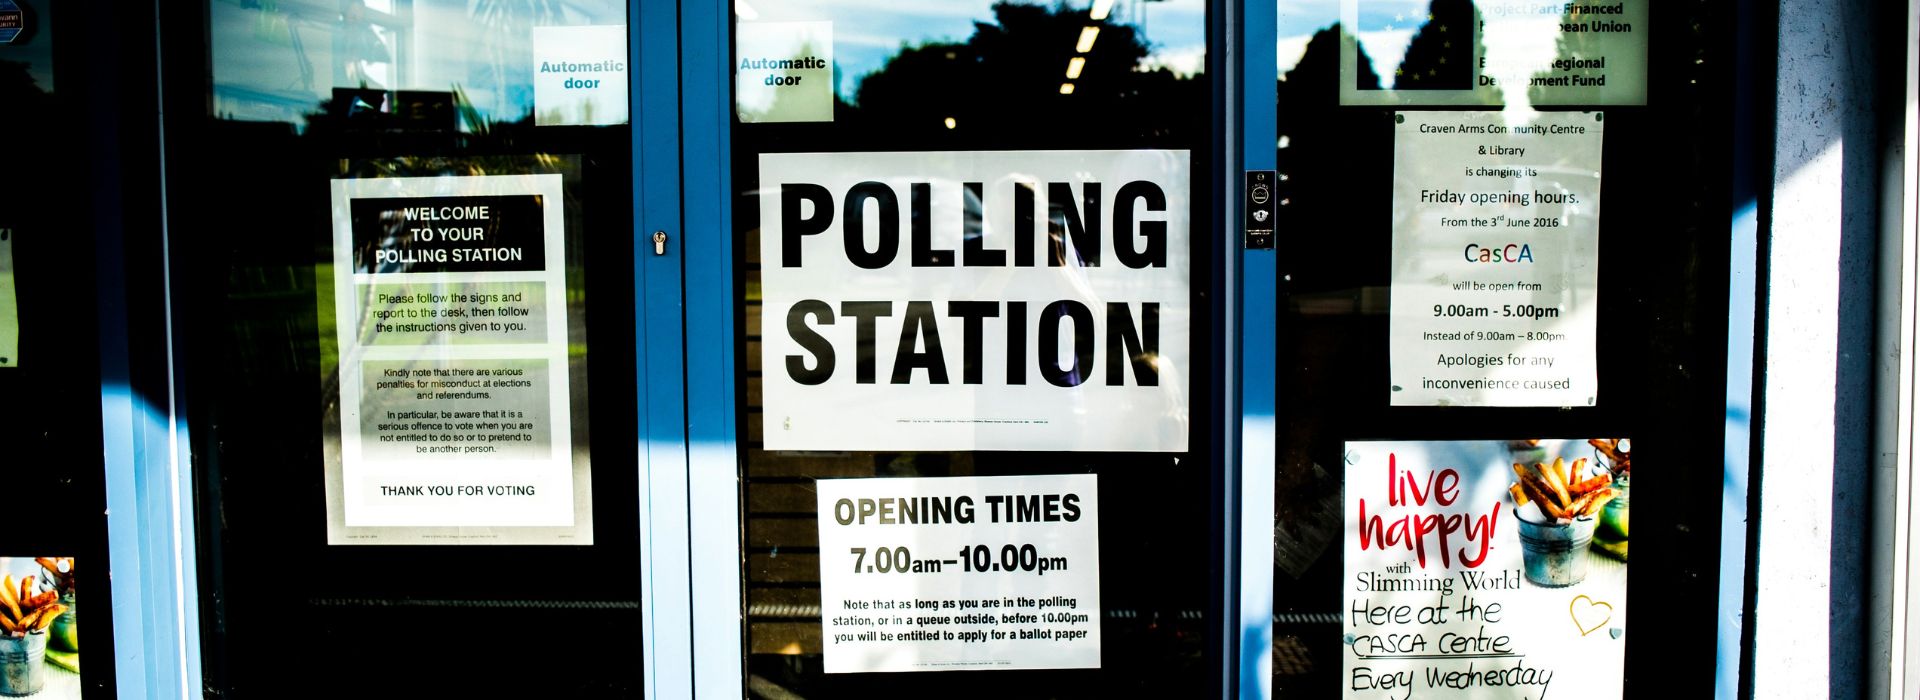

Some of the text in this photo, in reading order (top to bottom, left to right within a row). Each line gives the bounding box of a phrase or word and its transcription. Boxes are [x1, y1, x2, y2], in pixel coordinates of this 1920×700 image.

[1481, 3, 1623, 16] Project Part-Financed
[1591, 20, 1632, 33] Union
[541, 60, 624, 73] Automatic
[740, 56, 826, 70] Automatic
[564, 77, 600, 89] door
[764, 74, 802, 86] door
[1571, 74, 1606, 87] Fund
[1419, 124, 1455, 134] Craven
[1458, 124, 1485, 134] Arms
[1549, 124, 1585, 134] Centre
[1478, 145, 1525, 157] & Library
[1465, 167, 1537, 179] is changing its
[1420, 189, 1580, 206] Friday opening hours.
[404, 206, 490, 222] WELCOME
[780, 180, 1168, 270] POLLING
[1441, 217, 1468, 227] From
[1470, 217, 1488, 227] the
[1506, 217, 1531, 227] June
[1533, 217, 1559, 227] 2016
[410, 227, 484, 242] TO YOUR
[375, 247, 523, 264] POLLING STATION
[1464, 243, 1534, 263] CasCA
[1452, 281, 1542, 293] will be open from
[379, 292, 522, 305] Please follow the signs and
[373, 306, 529, 321] report to the desk, then follow
[1433, 304, 1559, 320] 9.00am 5.00pm
[376, 321, 527, 334] the instructions given to you.
[1423, 331, 1461, 341] Instead
[1463, 330, 1475, 341] of
[1476, 331, 1515, 341] 9.00am
[785, 298, 1161, 388] STATION
[1437, 353, 1555, 368] Apologies for any
[383, 368, 410, 379] Kindly
[412, 368, 431, 377] note
[433, 368, 450, 377] that
[452, 368, 474, 376] there
[491, 368, 523, 376] various
[376, 379, 531, 390] penalties for misconduct at elections
[1422, 376, 1570, 389] inconvenience caused
[416, 391, 492, 400] and referendums.
[387, 410, 396, 419] In
[397, 410, 439, 421] particular,
[441, 410, 452, 419] be
[482, 410, 499, 418] that
[508, 410, 515, 418] is
[378, 422, 409, 431] serious
[411, 422, 442, 431] offence
[444, 422, 452, 430] to
[455, 422, 474, 430] vote
[476, 422, 499, 430] when
[501, 423, 517, 432] you
[380, 434, 394, 442] not
[396, 433, 427, 442] entitled
[429, 434, 438, 442] to
[440, 433, 451, 442] do
[488, 433, 521, 443] pretend
[416, 445, 496, 454] be another person.
[1388, 452, 1460, 507] live
[381, 485, 536, 496] THANK YOU FOR VOTING
[834, 493, 1081, 525] OPENING TIMES
[1358, 498, 1501, 569] happy!
[1386, 561, 1411, 574] with
[1356, 569, 1521, 596] Slimming World
[843, 596, 1077, 611] Note that as long as you are in the polling
[1351, 594, 1502, 627] Here at the
[832, 612, 1089, 628] station, or in a queue outside, before 10.00pm
[834, 629, 1088, 644] you will be entitled to apply for a ballot paper
[1351, 625, 1512, 657] CASCA Centre
[1351, 659, 1553, 700] Every Wednesday
